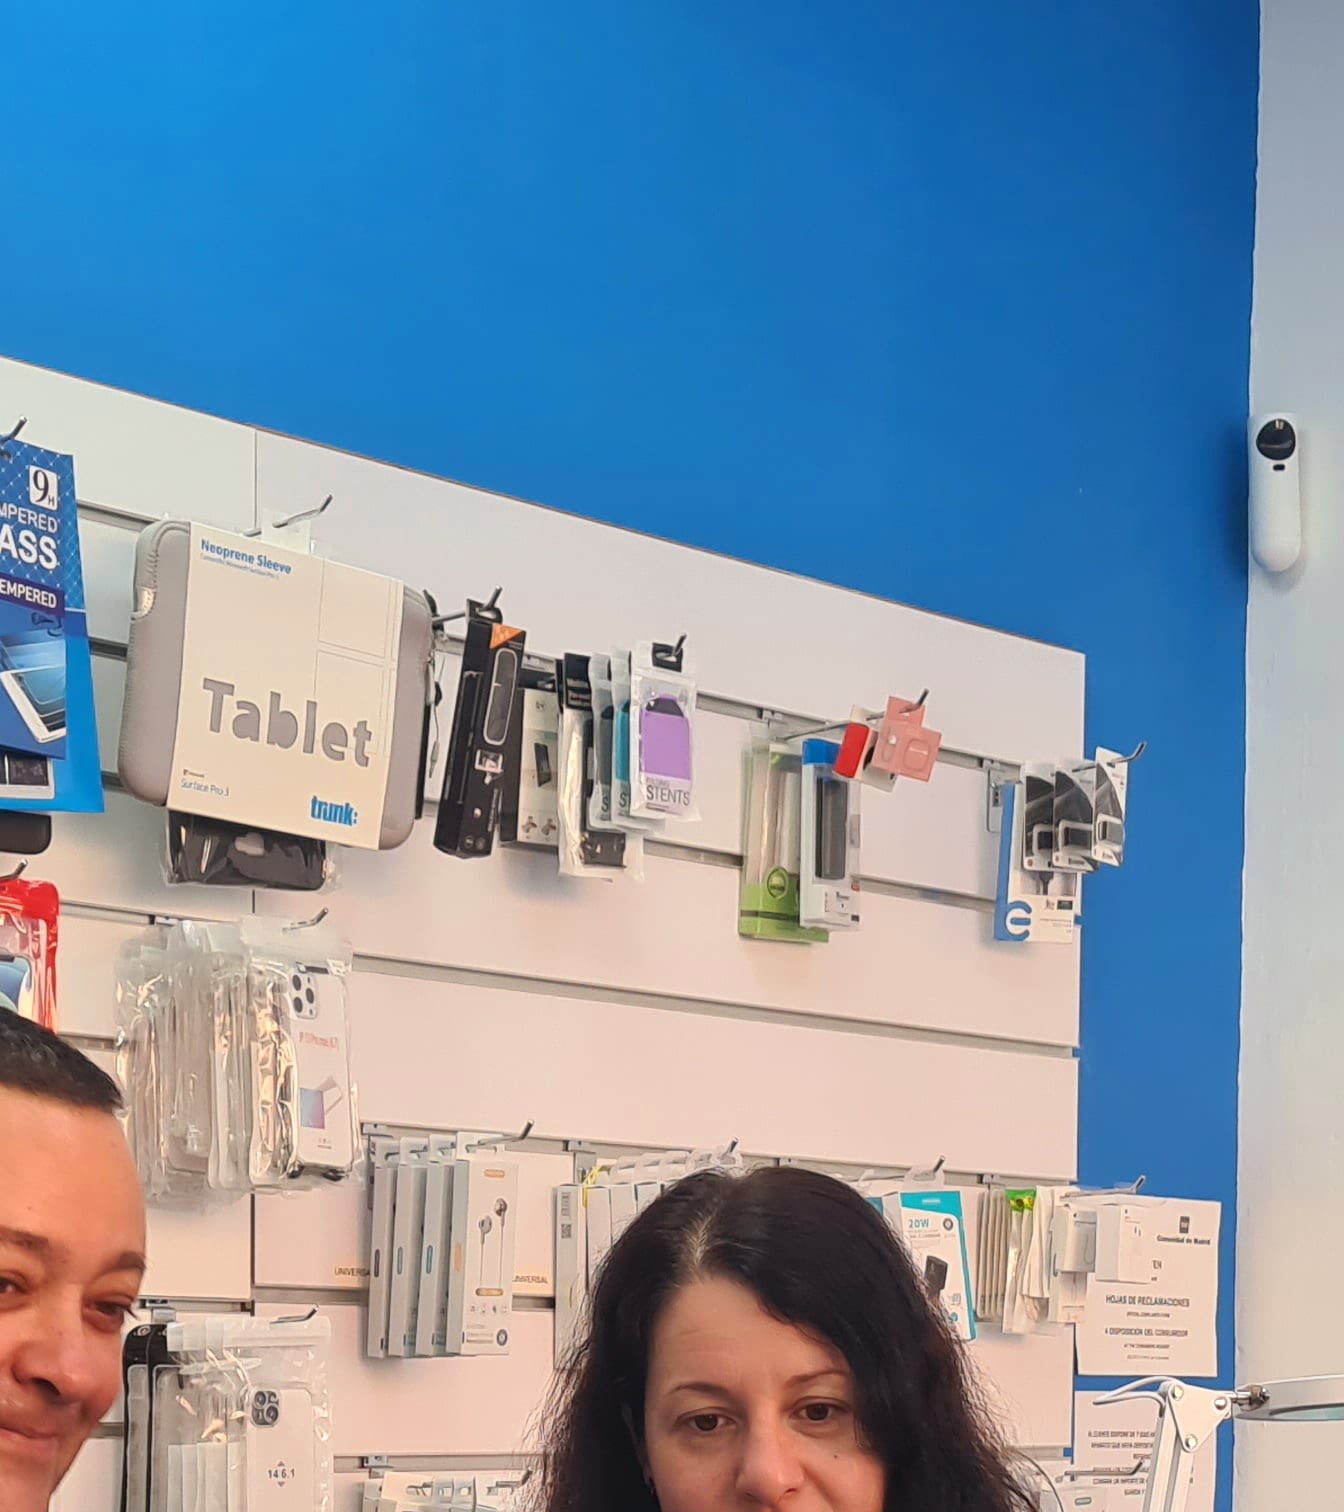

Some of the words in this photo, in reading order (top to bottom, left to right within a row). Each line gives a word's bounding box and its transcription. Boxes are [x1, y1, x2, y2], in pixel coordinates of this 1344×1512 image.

[201, 538, 255, 564] Neoprene
[256, 554, 292, 575] Sleeve
[203, 677, 373, 768] Tablet
[646, 784, 690, 807] STENTS
[334, 1267, 369, 1277] UNIVERSA
